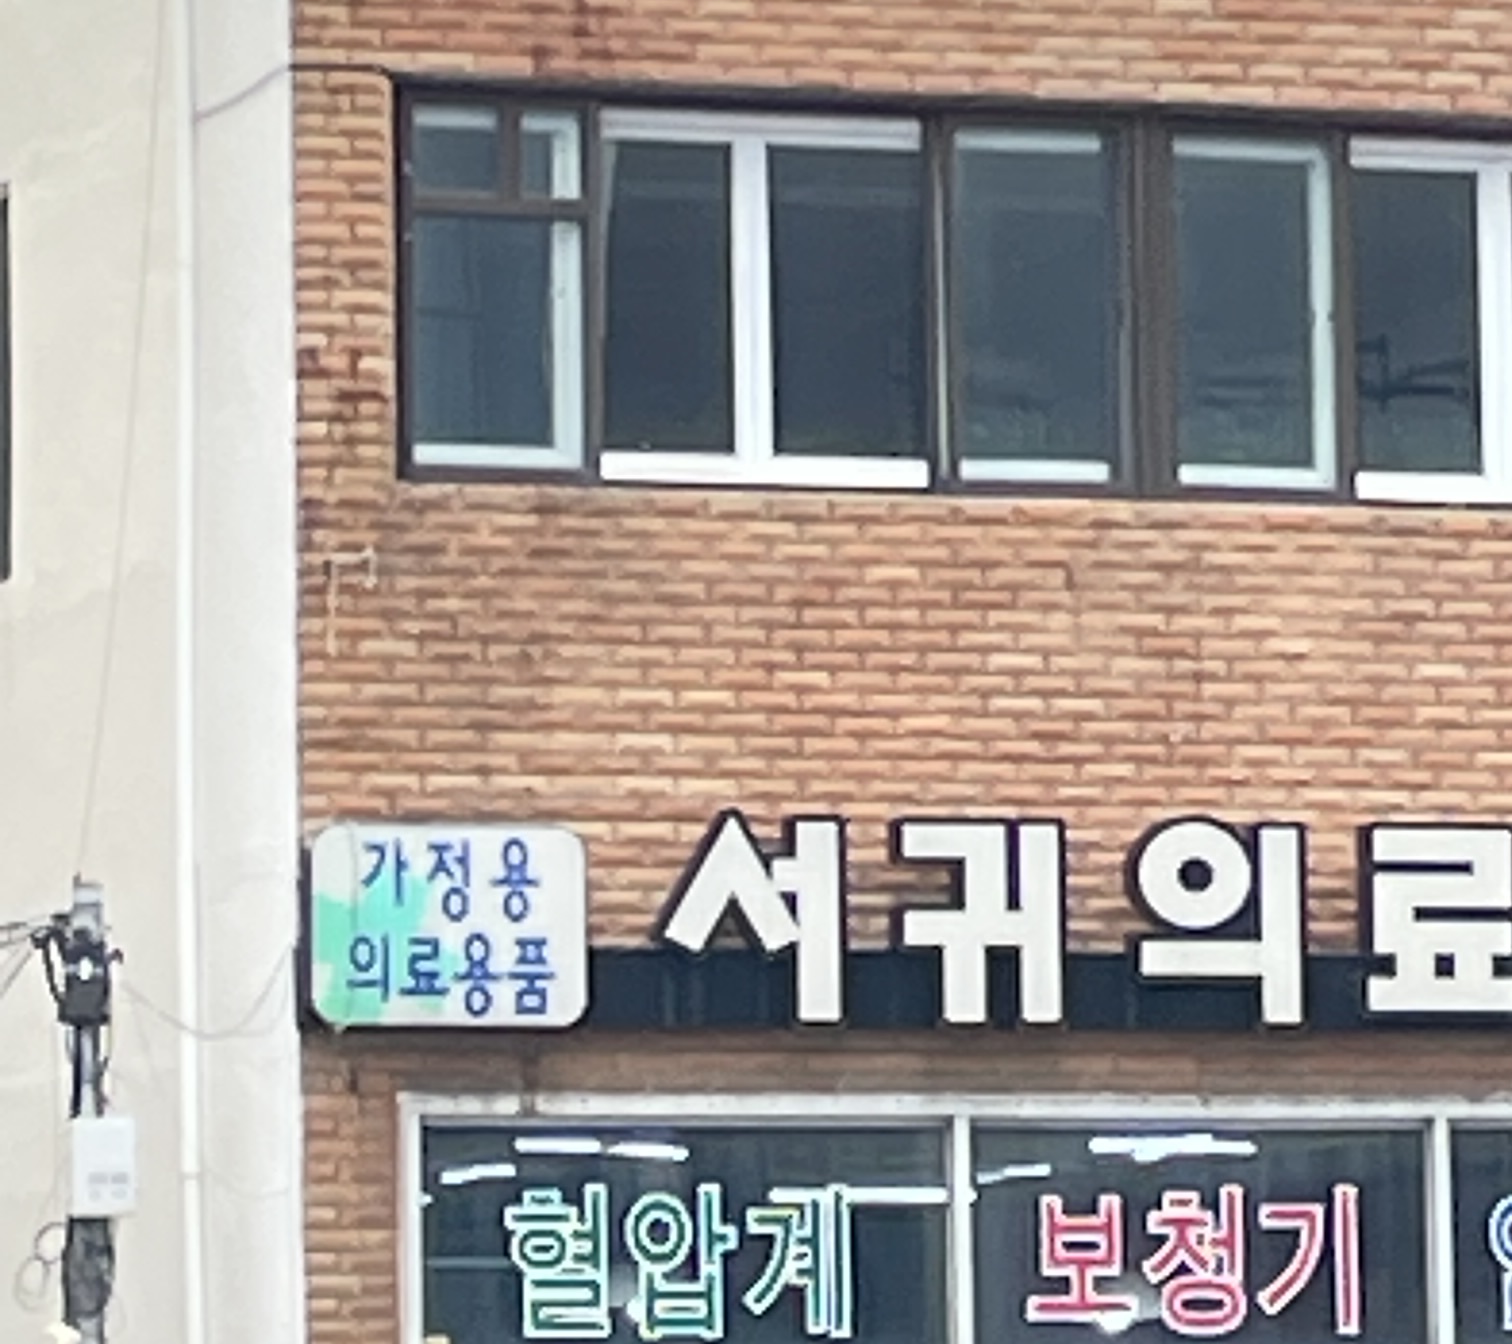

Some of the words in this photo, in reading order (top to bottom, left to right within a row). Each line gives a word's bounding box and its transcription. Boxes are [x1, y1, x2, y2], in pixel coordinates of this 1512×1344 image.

[361, 837, 540, 923] 가정용
[347, 932, 556, 1018] 의료용품
[504, 1183, 852, 1339] 혈압계
[1025, 1184, 1362, 1338] 보청기
